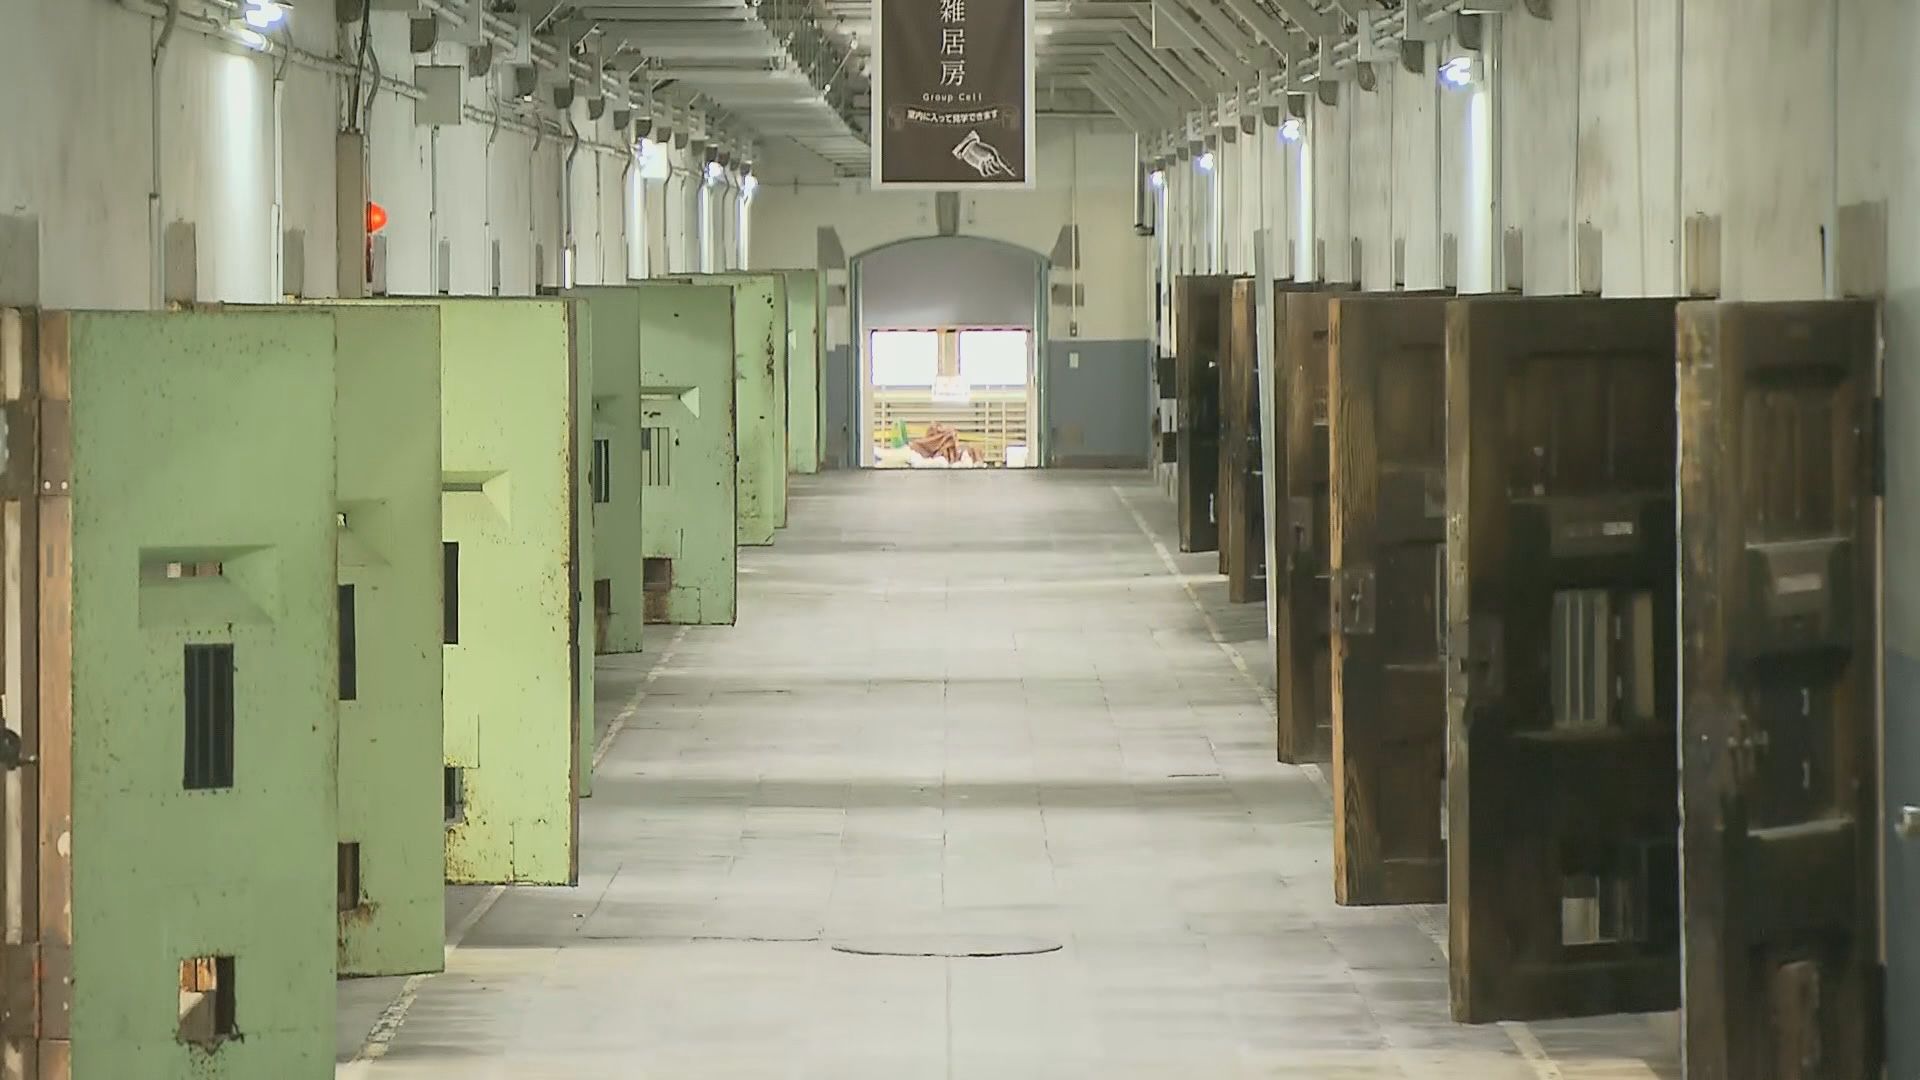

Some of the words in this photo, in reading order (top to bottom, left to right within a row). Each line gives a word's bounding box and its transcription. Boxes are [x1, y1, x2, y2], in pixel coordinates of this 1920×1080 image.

[940, 0, 965, 86] 雑居房
[922, 92, 953, 103] Group
[958, 92, 982, 102] Cell
